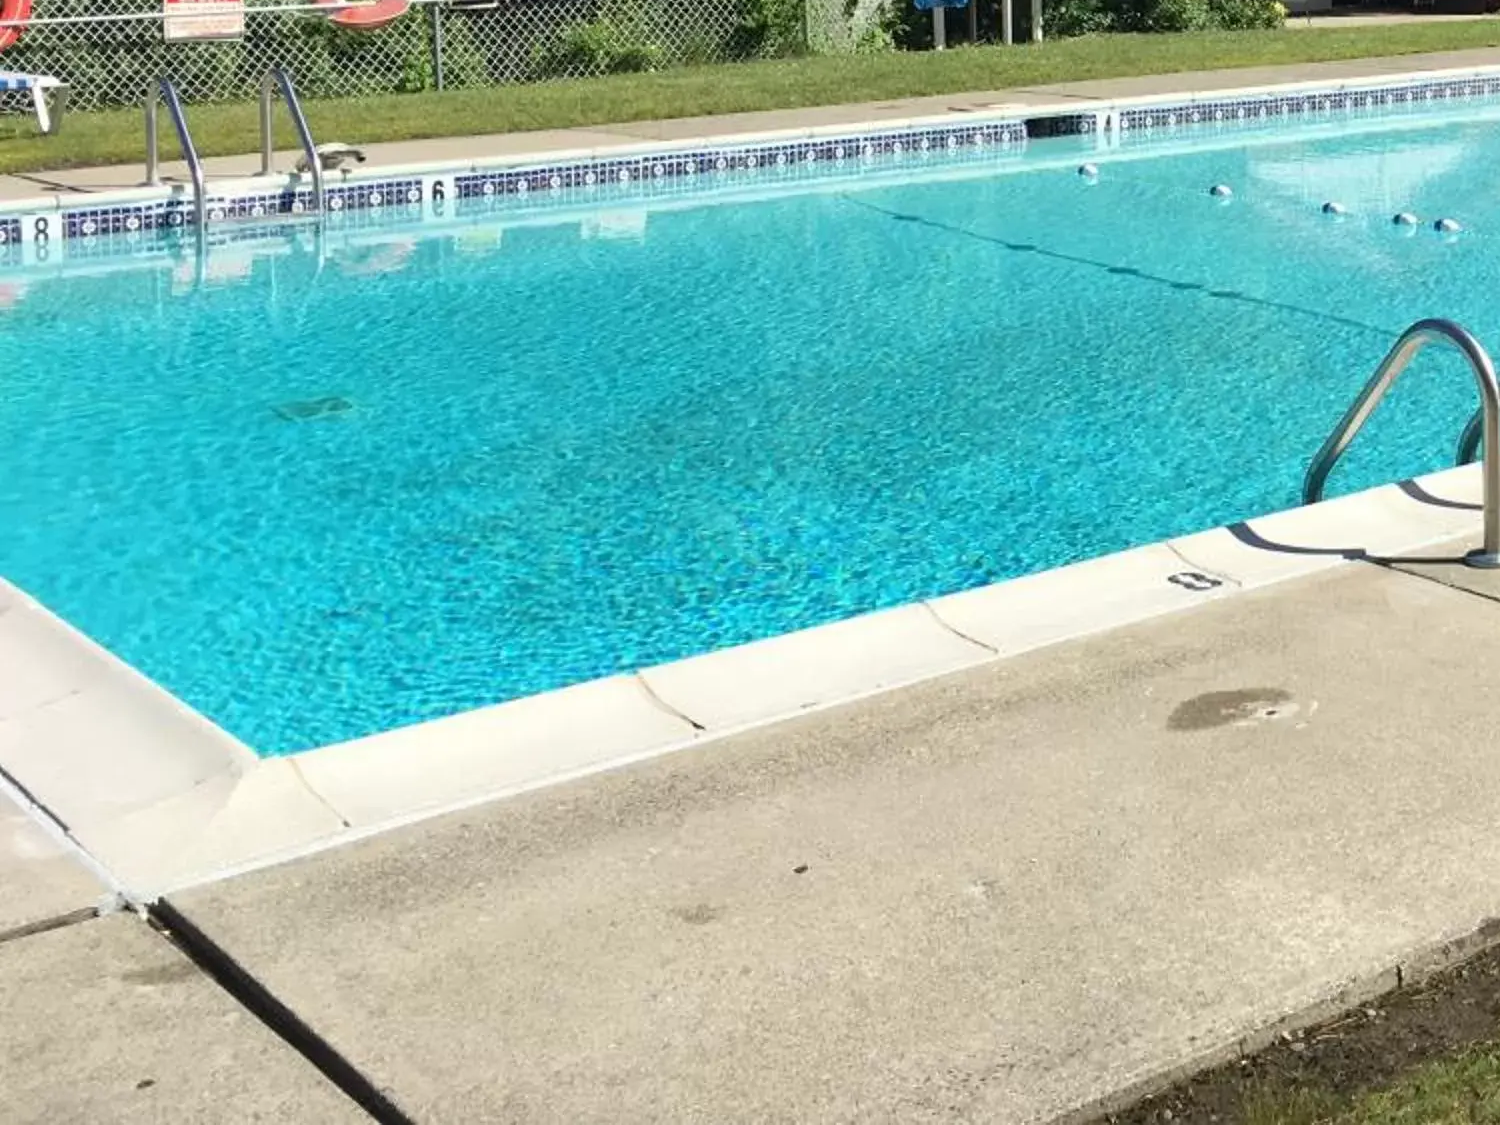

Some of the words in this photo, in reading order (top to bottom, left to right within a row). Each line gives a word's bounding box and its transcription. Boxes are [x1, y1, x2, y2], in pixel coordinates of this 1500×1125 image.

[431, 180, 445, 203] 6
[34, 216, 49, 246] 8
[1167, 572, 1222, 591] 8
